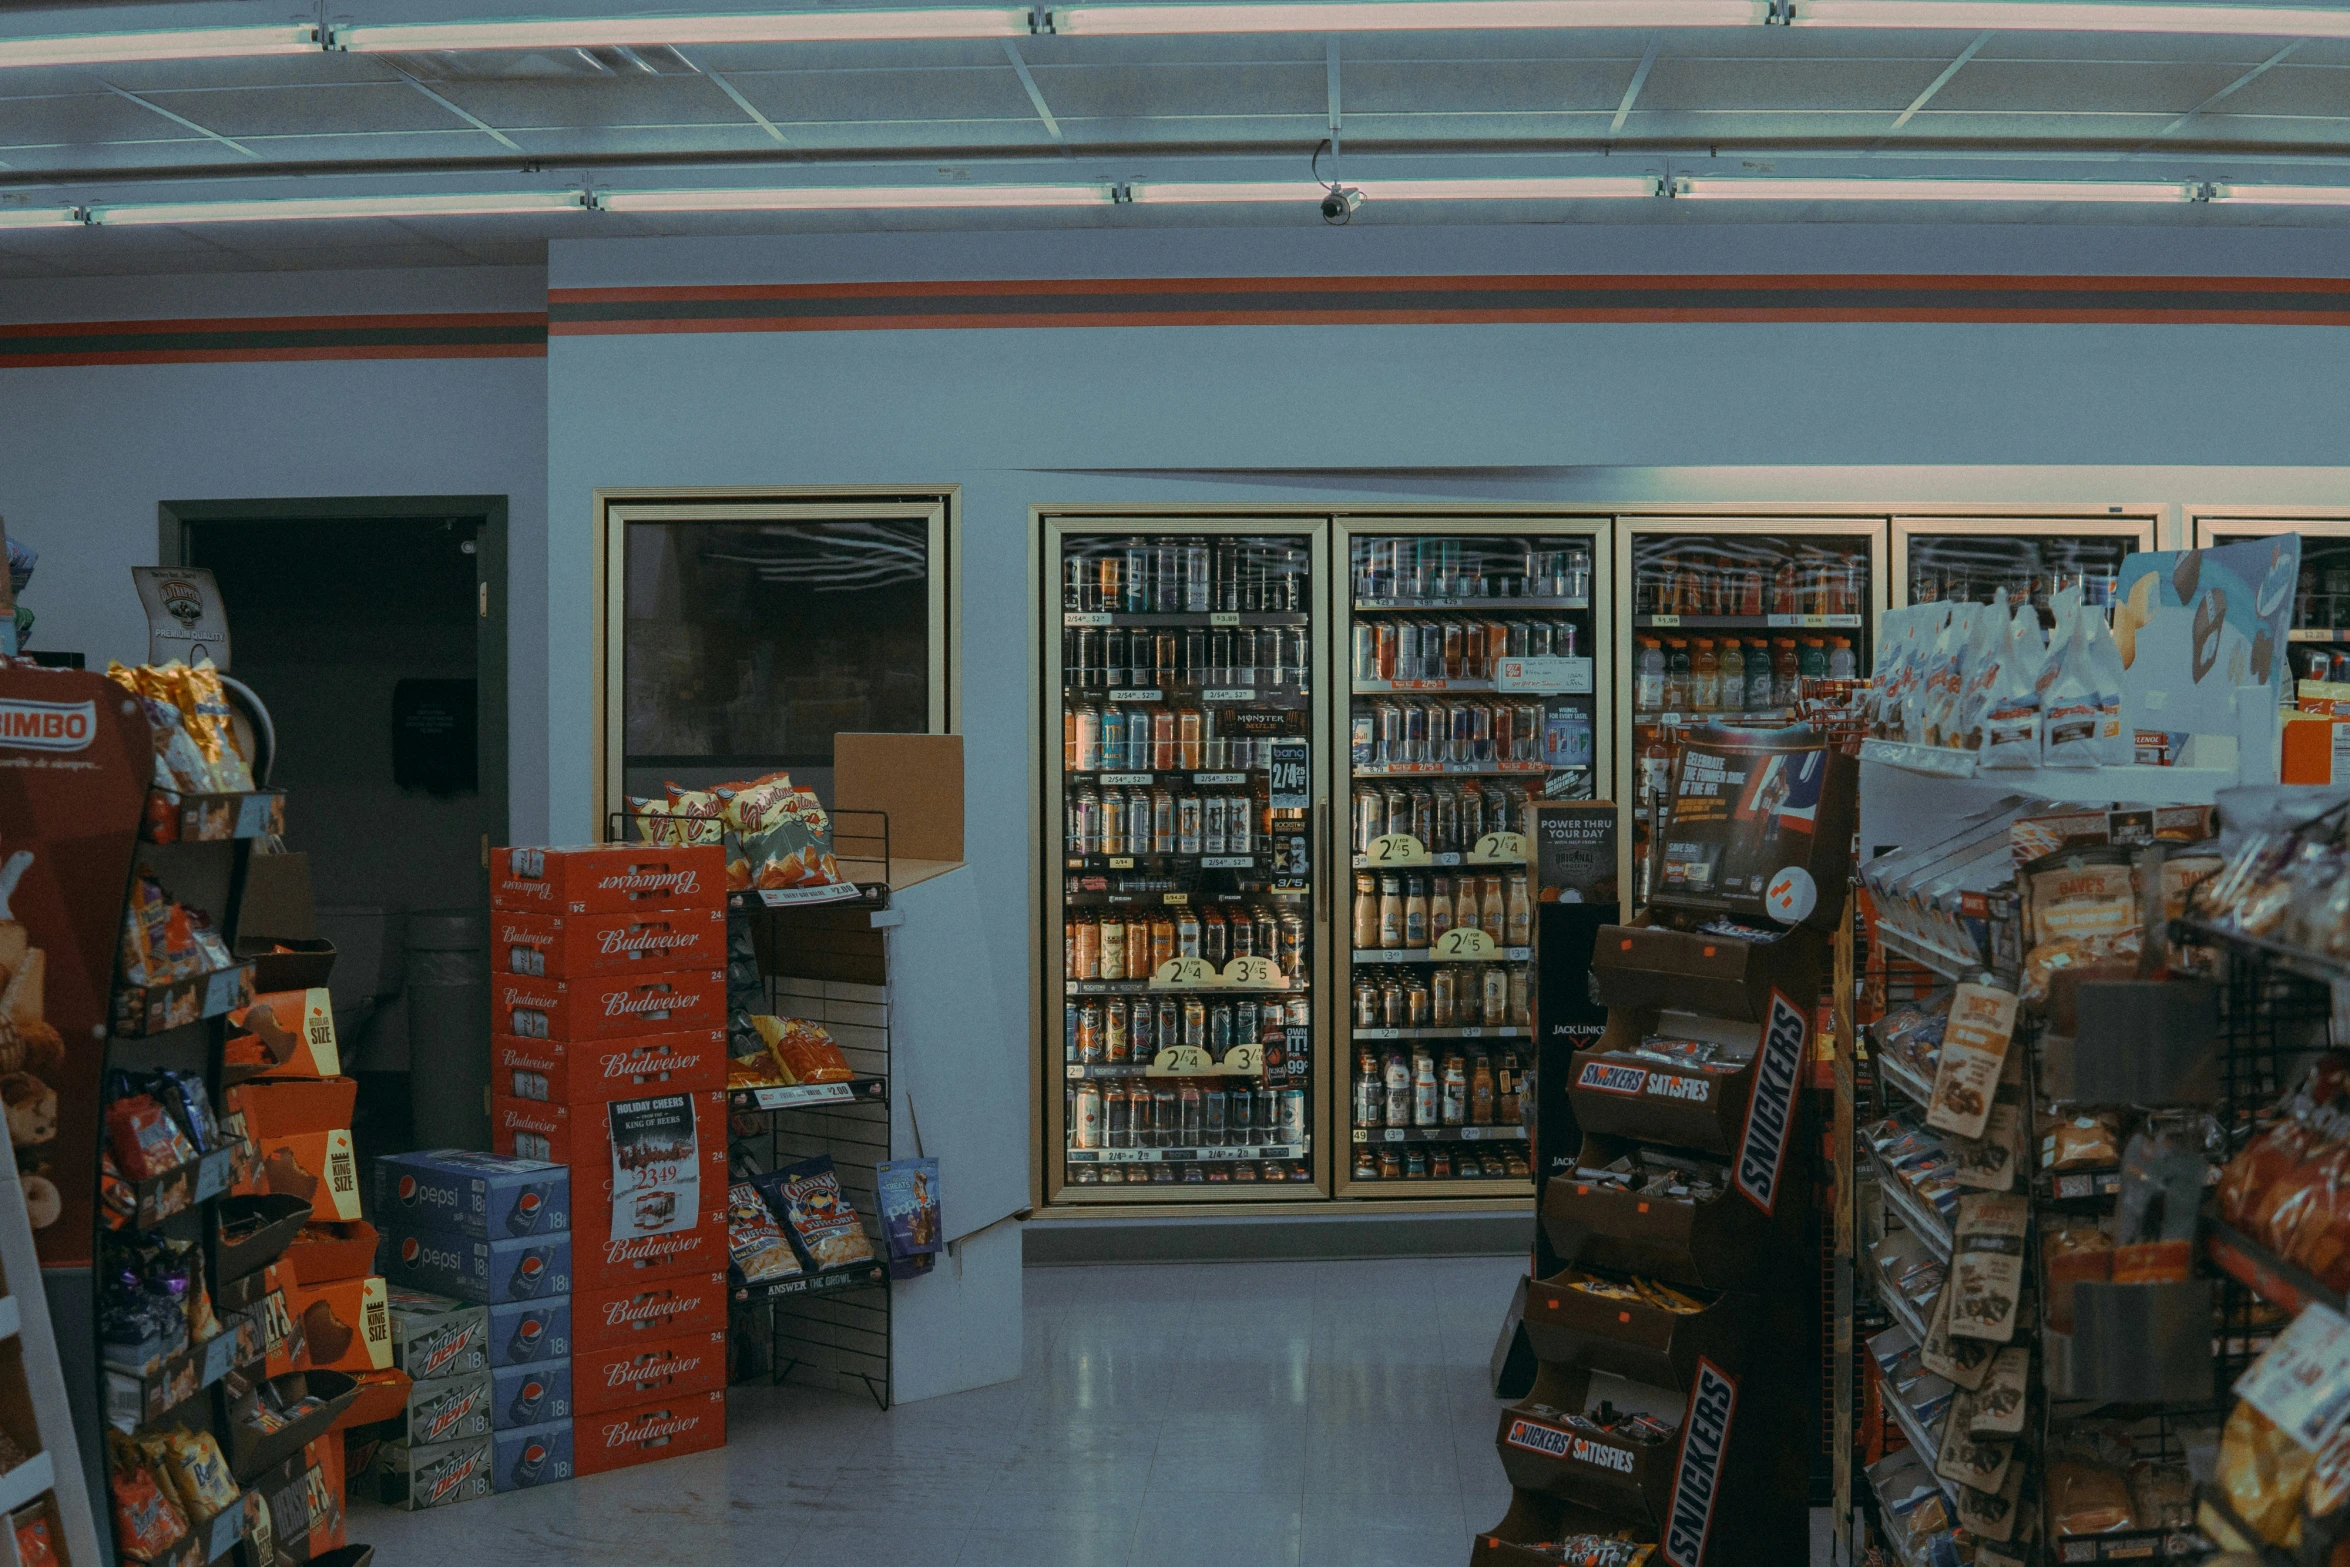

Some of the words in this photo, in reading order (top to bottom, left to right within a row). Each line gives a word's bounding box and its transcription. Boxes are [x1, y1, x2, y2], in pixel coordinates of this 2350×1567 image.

[155, 628, 191, 639] PREMIUM
[191, 631, 224, 641] QUALITY
[0, 712, 87, 739] IMBO
[1237, 713, 1285, 722] MONSTER
[1273, 747, 1305, 760] bang
[1541, 819, 1581, 829] POWER
[1583, 819, 1612, 829] THRU
[1549, 829, 1580, 838] YOUR
[1582, 829, 1605, 838] DAY
[598, 870, 700, 894] Budweiser
[831, 884, 854, 895] $2.00
[2059, 877, 2106, 896] DAVE'S
[711, 911, 722, 919] 24
[502, 926, 554, 945] Budweiser
[597, 929, 700, 954] Budweiser
[711, 971, 722, 980] 24
[503, 988, 557, 1008] Budweiser
[601, 991, 700, 1016] Budweiser
[309, 1016, 329, 1027] REGULAR
[1552, 1025, 1577, 1035] JACK
[310, 1027, 332, 1044] SIZE
[711, 1031, 722, 1039] 24
[1286, 1027, 1308, 1036] OWN
[1286, 1035, 1308, 1052] IT!
[502, 1048, 555, 1070] Budweiser
[600, 1051, 700, 1077] Budweiser
[1287, 1060, 1309, 1074] 99¢
[712, 1091, 722, 1100] 24
[827, 1085, 849, 1096] $2.00
[1647, 1073, 1710, 1102] SATISFIES
[616, 1099, 650, 1115] HOLIDAY
[652, 1096, 685, 1110] CHEERS
[1742, 1003, 1802, 1199] SNICKERS
[503, 1110, 557, 1132] Budweiser
[626, 1120, 645, 1130] KING
[646, 1119, 656, 1127] OF
[657, 1116, 681, 1126] BEERS
[712, 1151, 723, 1160] 24
[1552, 1156, 1576, 1166] JACK
[332, 1163, 351, 1176] KING
[334, 1175, 354, 1192] SIZE
[885, 1180, 911, 1190] TREATS
[419, 1185, 459, 1208] pepsi
[471, 1194, 482, 1212] 18
[514, 1214, 531, 1227] pepsi
[549, 1211, 563, 1229] 18
[712, 1213, 723, 1221] 24
[805, 1214, 856, 1229] PUFFCORN
[602, 1234, 702, 1264] Budweiser
[422, 1248, 461, 1270] pepsi
[474, 1258, 485, 1275] 18
[517, 1278, 532, 1290] pepsi
[550, 1275, 565, 1292] 18
[711, 1272, 723, 1282] 24
[768, 1280, 806, 1296] ANSWER
[808, 1278, 824, 1289] THE
[825, 1275, 851, 1287] GROWL
[602, 1295, 701, 1325] Budweiser
[367, 1313, 386, 1326] KING
[369, 1324, 388, 1342] SIZE
[711, 1332, 721, 1341] 24
[515, 1341, 531, 1353] pepsi
[550, 1338, 564, 1355] 18
[467, 1352, 481, 1369] 18
[603, 1355, 700, 1387] Budweiser
[710, 1391, 721, 1400] 24
[517, 1404, 533, 1416] pepsi
[551, 1400, 564, 1416] 18
[470, 1416, 484, 1433] 18
[602, 1415, 699, 1448] Budweiser
[1573, 1437, 1634, 1474] SATISFIES
[520, 1467, 536, 1479] pepsi
[553, 1461, 567, 1479] 18
[1669, 1370, 1731, 1567] SNICKERS
[471, 1478, 485, 1495] 18
